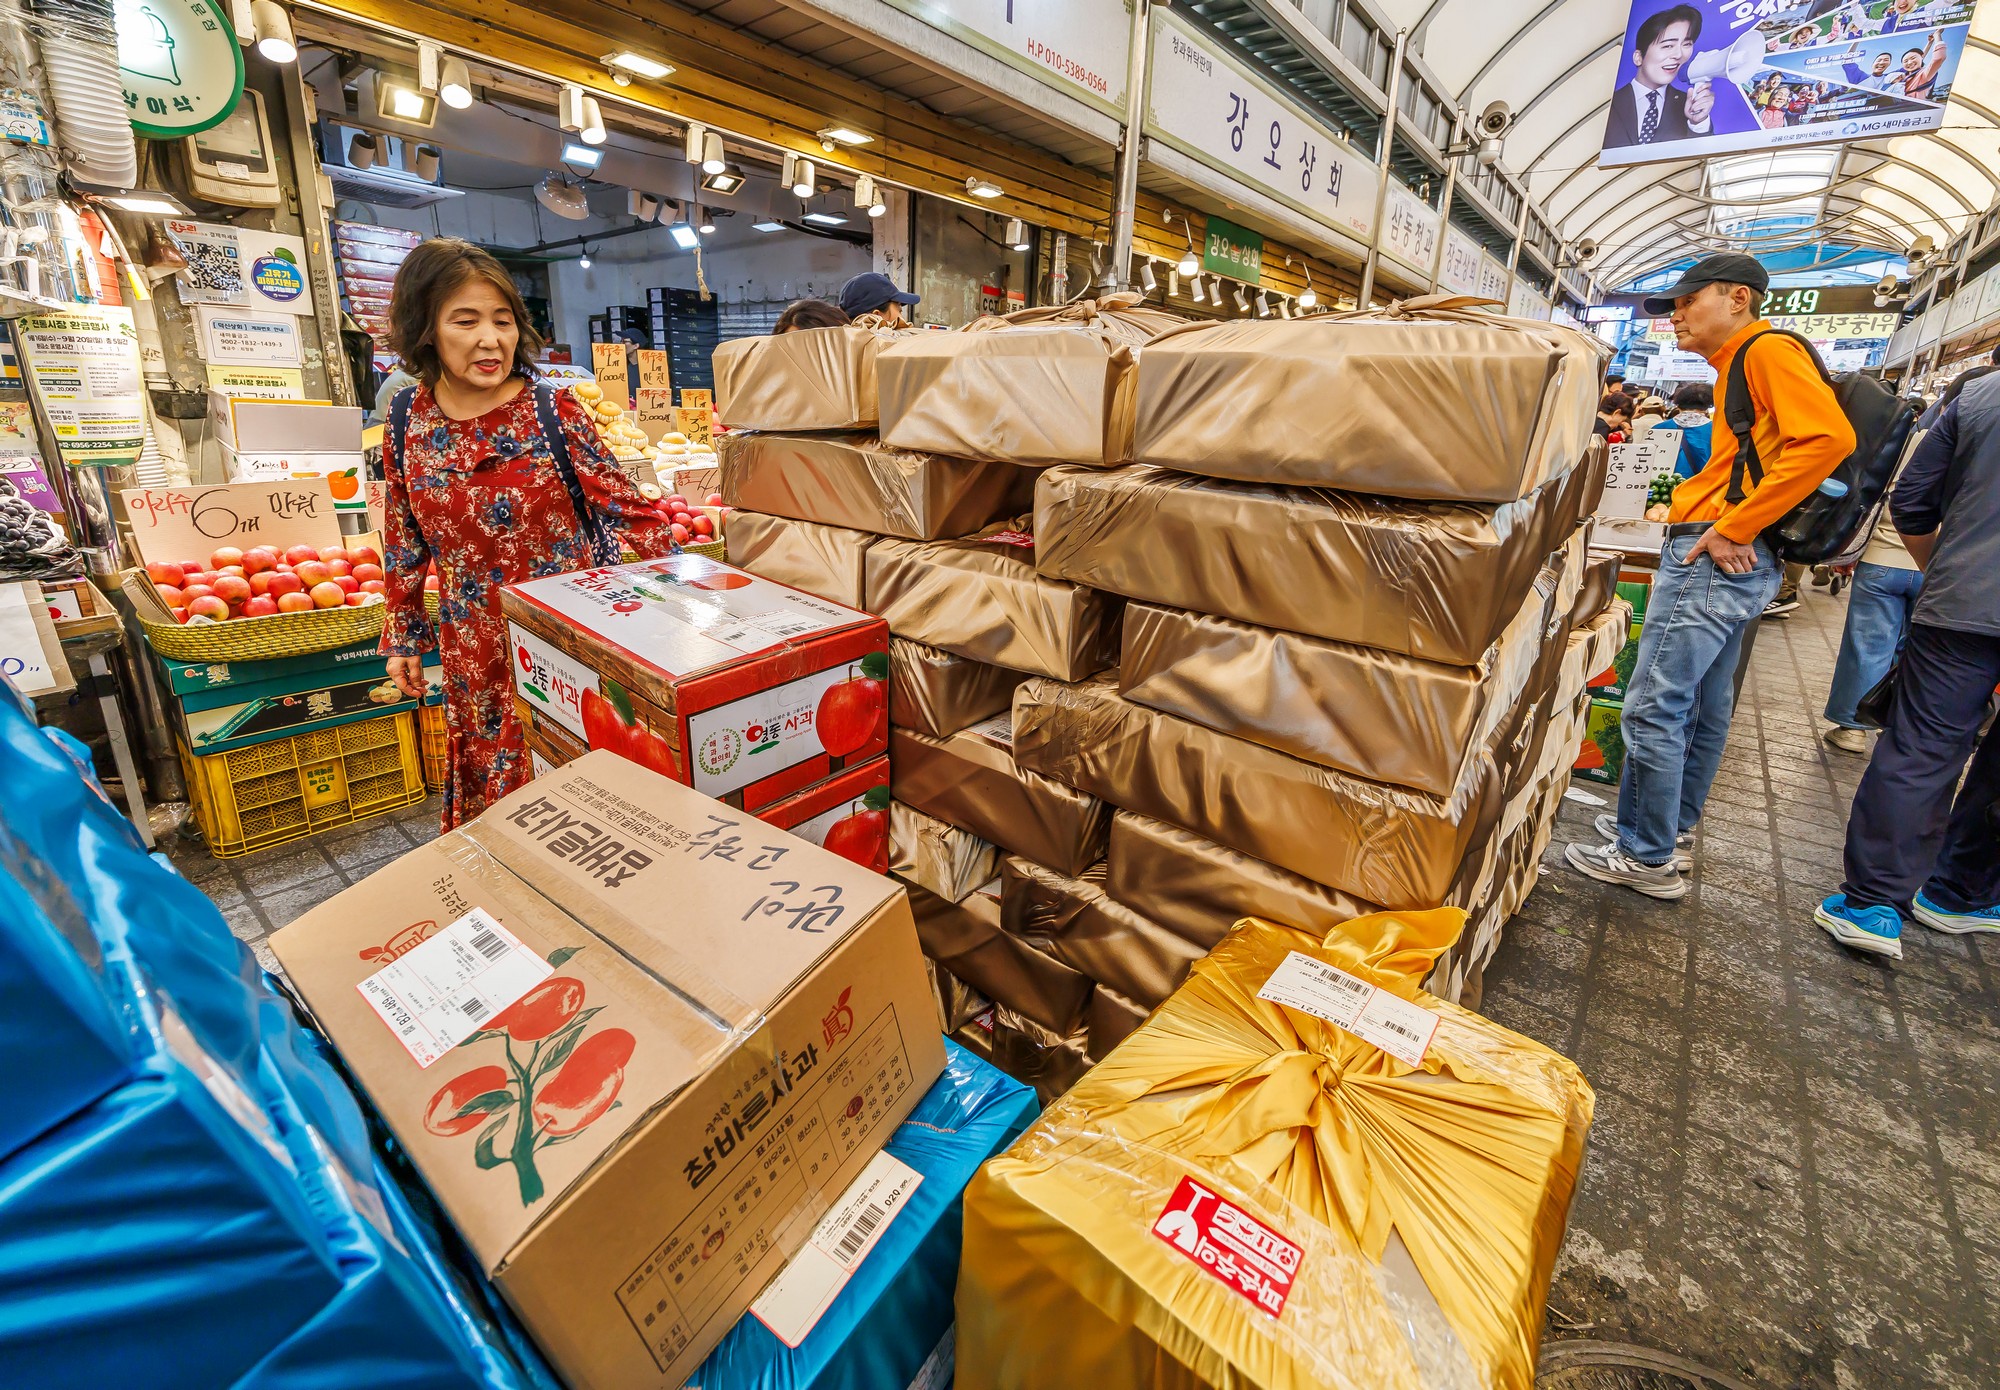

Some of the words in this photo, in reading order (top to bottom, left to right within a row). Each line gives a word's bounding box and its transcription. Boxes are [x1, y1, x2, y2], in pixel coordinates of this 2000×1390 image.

[1028, 37, 1044, 59] H.P
[1046, 48, 1107, 95] 010-5389-0564
[1172, 36, 1213, 77] 청과위탁판매
[1227, 92, 1342, 208] 강오상회
[1391, 204, 1434, 262] 삼동청과
[1211, 233, 1229, 260] 강오
[1241, 242, 1260, 270] 상회
[256, 276, 300, 289] 피해지원금
[262, 268, 291, 278] 고유가
[32, 319, 67, 330] 전통시장
[70, 321, 110, 332] 환급행사
[223, 378, 254, 387] 전통시장
[256, 379, 287, 387] 환급행사
[1609, 463, 1649, 473] (국산)
[1611, 446, 1652, 462] 당근
[130, 489, 194, 528] 아리수
[267, 491, 320, 519] 만원
[517, 644, 549, 694] 영동
[551, 677, 581, 714] 사과
[1604, 686, 1621, 695] 20kg
[746, 722, 781, 743] 영동
[784, 710, 814, 731] 사과
[711, 751, 731, 766] 협의회
[1591, 768, 1608, 778] 20kg
[606, 808, 651, 836] 참바른사과는
[505, 796, 654, 889] 참바른사과
[381, 996, 397, 1011] 489
[836, 1114, 847, 1128] 20
[863, 1084, 874, 1097] 25
[877, 1070, 887, 1083] 28
[889, 1055, 899, 1069] 29
[841, 1126, 851, 1140] 30
[855, 1111, 865, 1125] 32
[868, 1097, 878, 1110] 35
[881, 1082, 890, 1095] 38
[893, 1068, 903, 1081] 40
[682, 1043, 819, 1190] 참바른사과
[705, 1102, 731, 1136] 정직한
[797, 1116, 818, 1142] 생산자
[845, 1140, 855, 1153] 45
[858, 1124, 868, 1137] 50
[872, 1109, 881, 1122] 55
[884, 1094, 894, 1107] 60
[896, 1080, 906, 1093] 65
[755, 1113, 794, 1158] 표시사항
[763, 1142, 787, 1170] 아오리
[654, 1236, 681, 1266] 드세요
[733, 1228, 766, 1265] 국내산
[1195, 1236, 1284, 1314] 파손주의
